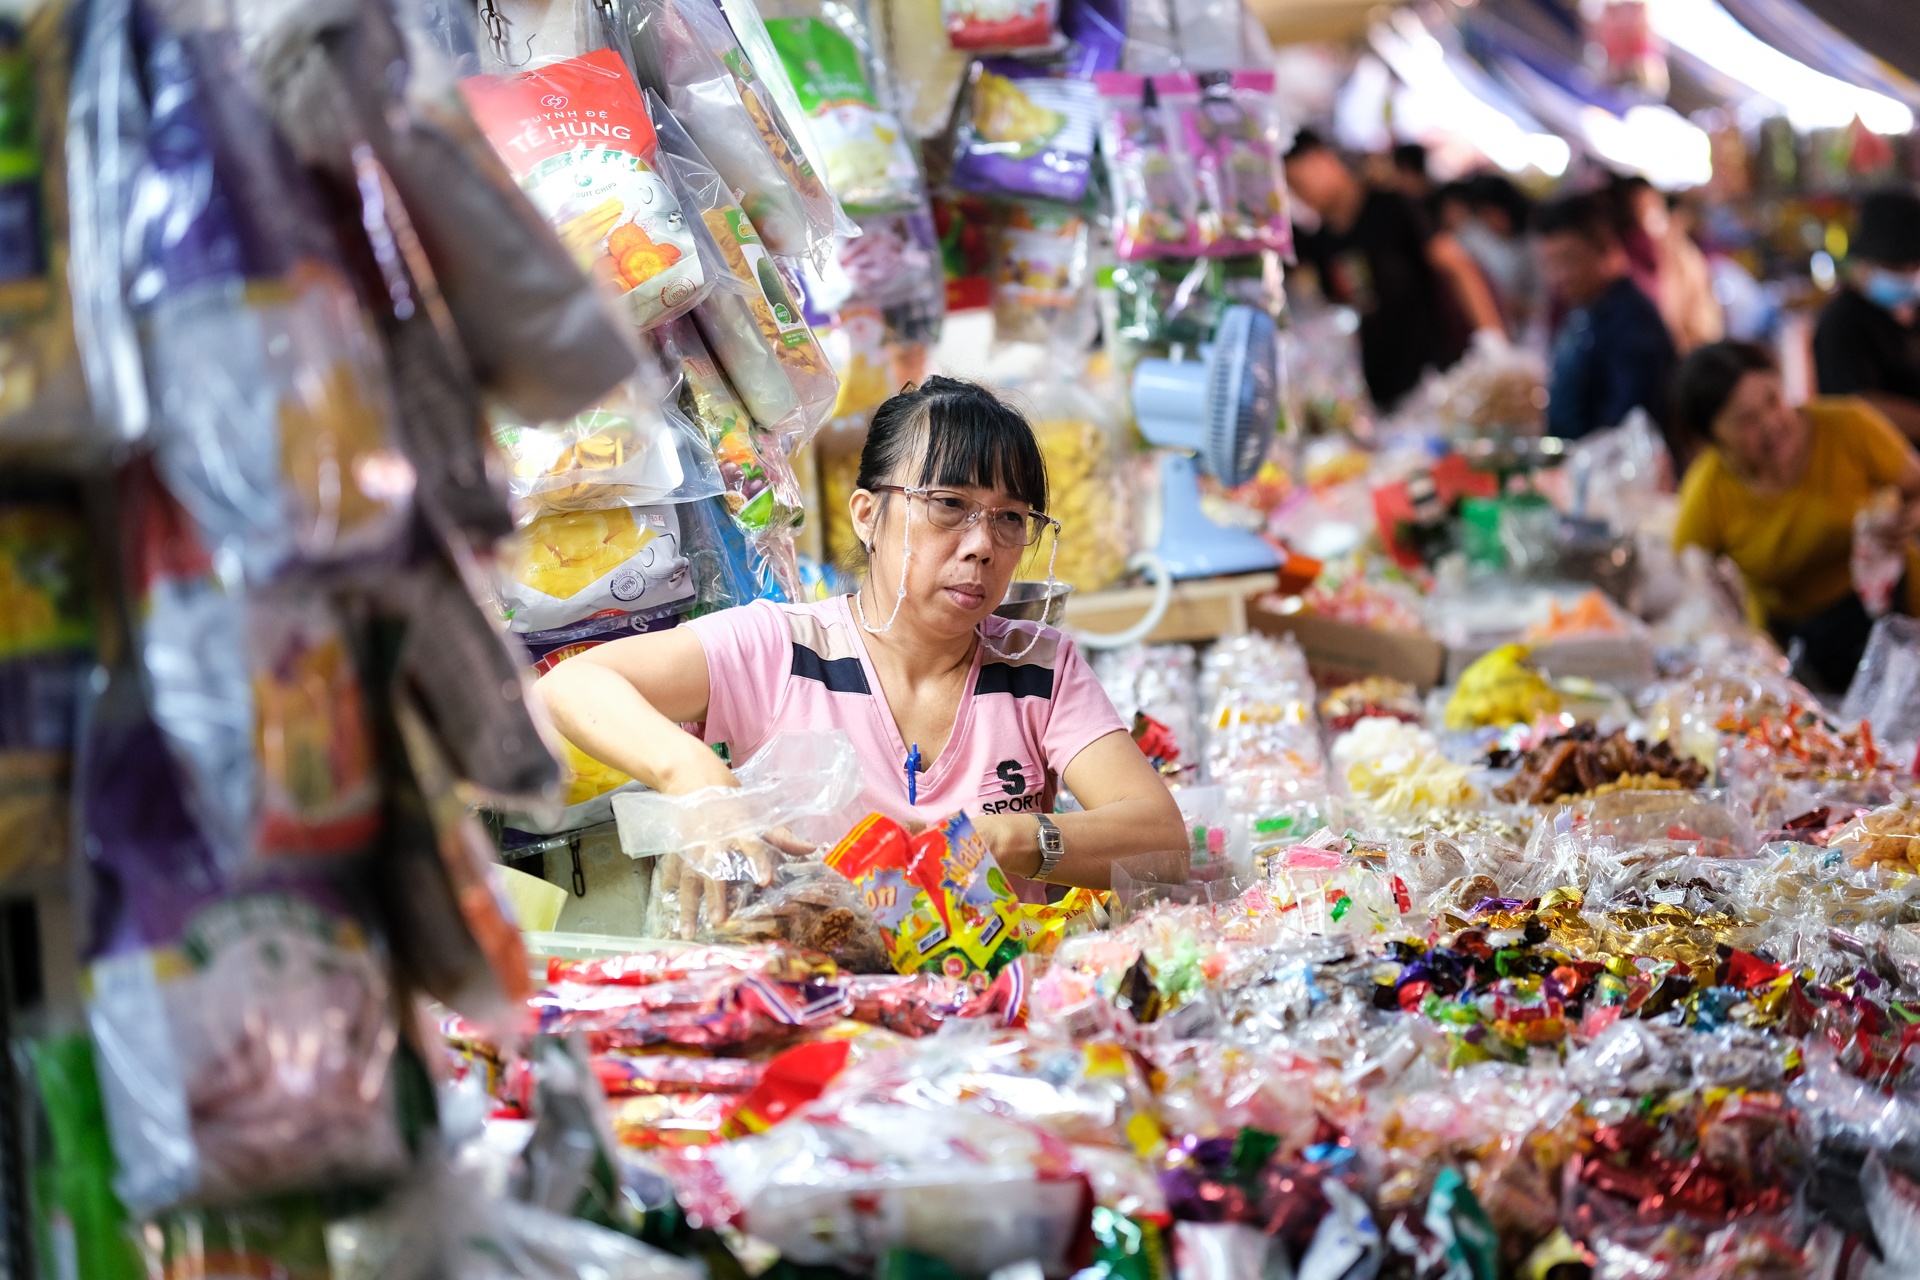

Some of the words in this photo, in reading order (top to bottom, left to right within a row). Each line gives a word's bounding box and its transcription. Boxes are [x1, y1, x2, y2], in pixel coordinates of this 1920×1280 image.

[585, 109, 608, 119] ĐỆ
[546, 118, 631, 140] HÙNG
[595, 182, 617, 195] CHIPS
[671, 287, 687, 300] 100%
[620, 578, 636, 592] 100%
[996, 759, 1026, 795] S
[983, 792, 1042, 814] SPORT
